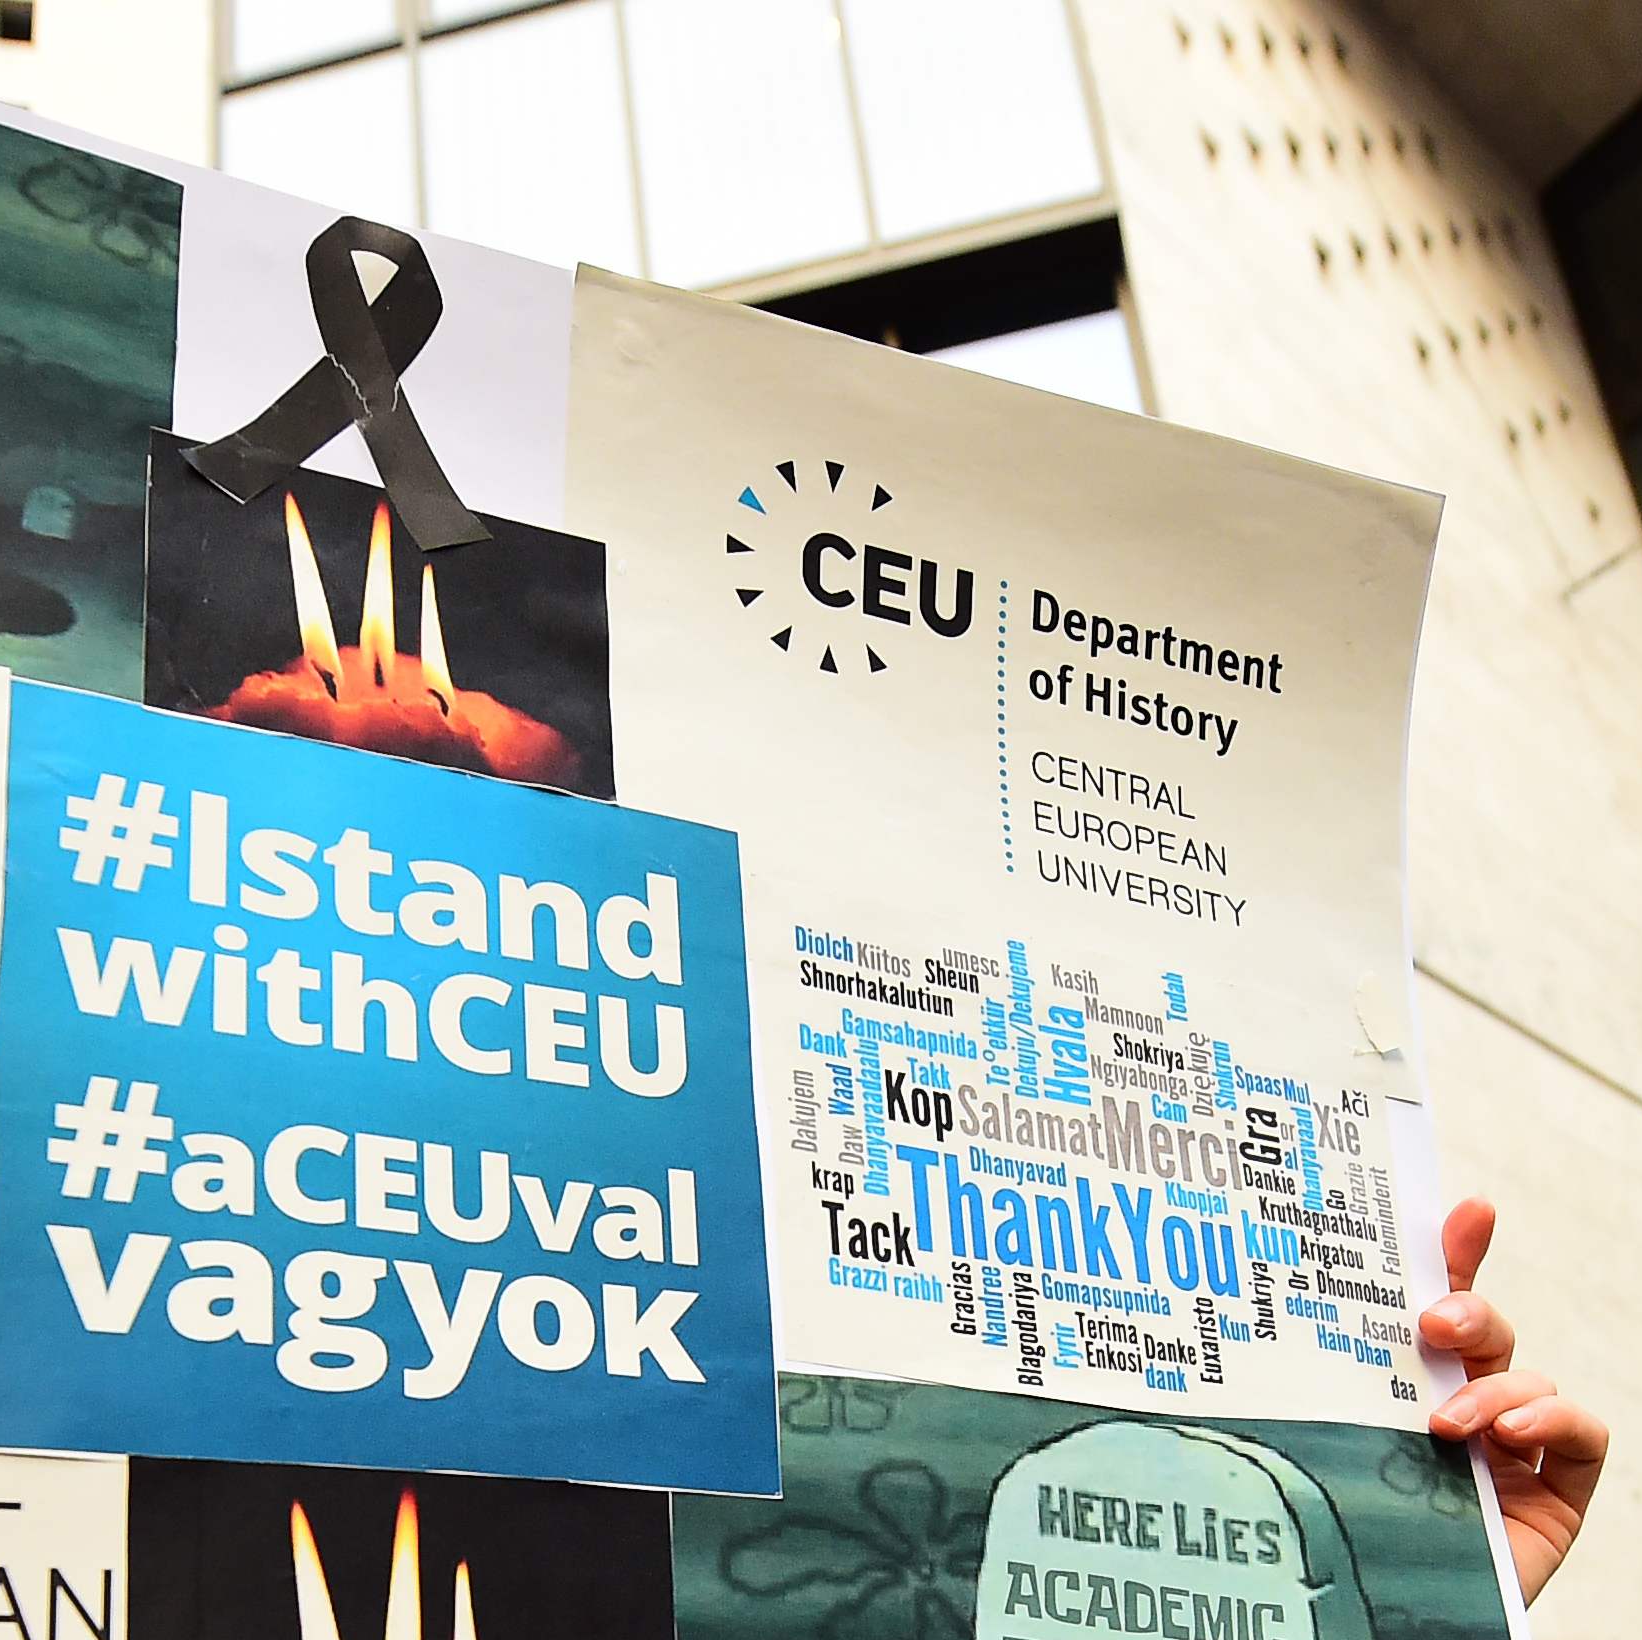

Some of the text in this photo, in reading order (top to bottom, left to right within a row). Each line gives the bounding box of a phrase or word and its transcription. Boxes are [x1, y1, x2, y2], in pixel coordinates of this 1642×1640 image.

[801, 531, 974, 639] CEU
[1032, 589, 1283, 694] Department
[1029, 664, 1238, 757] of History
[1032, 751, 1196, 820] CENTRAL
[1034, 801, 1227, 876] EUROPEAN
[58, 771, 684, 987] #Istand
[1037, 850, 1246, 928] UNIVERSITY
[795, 925, 854, 963] Diolch
[857, 941, 911, 978] Kiitos
[943, 947, 999, 978] umesc
[800, 960, 954, 1018] Shnorhakalutiun
[925, 958, 979, 994] Sheun
[1051, 963, 1099, 995] Kasih
[1161, 971, 1189, 1022] Todah
[55, 925, 689, 1098] withCEU
[842, 1007, 978, 1061] Gamsahapnida
[1084, 996, 1164, 1036] Mamnoon
[799, 1022, 847, 1059] Dank
[1038, 1005, 1092, 1107] Hvala
[1113, 1032, 1185, 1074] Shokriya
[826, 1062, 855, 1117] Waad
[907, 1056, 951, 1090] Takk
[1090, 1054, 1188, 1101] Ngiyabonga
[1212, 1040, 1237, 1111] Shokrun
[1234, 1065, 1282, 1097] Spaas
[1283, 1077, 1311, 1106] Mul
[788, 1069, 821, 1154] Dakujem
[885, 1068, 954, 1142] Kop
[958, 1083, 1105, 1161] Salamat
[1152, 1093, 1188, 1123] Cam
[838, 1124, 864, 1166] Daw
[1102, 1094, 1243, 1190] Merci
[1239, 1107, 1282, 1166] Gra
[1280, 1122, 1295, 1142] or
[1313, 1102, 1361, 1157] Xie
[46, 1075, 699, 1267] #aCEUval
[811, 1160, 855, 1200] krap
[969, 1145, 1067, 1187] Dhanyavad
[1242, 1163, 1296, 1196] Dankie
[1284, 1147, 1298, 1170] al
[1290, 1106, 1324, 1212] Dhanyavaad
[1164, 1181, 1229, 1218] Khopjai
[1325, 1189, 1346, 1211] Go
[1345, 1162, 1369, 1216] Grazie
[821, 1199, 916, 1267] Tack
[895, 1144, 1241, 1298] ThankYou
[1241, 1208, 1300, 1267] kun
[1258, 1195, 1377, 1242] Kruthagnathalu
[1368, 1166, 1402, 1277] Faleminderit
[828, 1257, 888, 1292] Grazzi
[1300, 1235, 1365, 1270] Arigatou
[946, 1260, 977, 1335] Gracias
[1041, 1272, 1172, 1317] Gomapsupnida
[1248, 1260, 1277, 1341] Shukriya
[1288, 1270, 1309, 1291] Or
[1316, 1269, 1406, 1310] Dhonnobaad
[44, 1223, 707, 1400] vagyok
[978, 1265, 1008, 1347] Nandree
[1008, 1271, 1046, 1387] Blagodariya
[1074, 1311, 1139, 1345] Terima
[1218, 1312, 1251, 1344] Kun
[1285, 1292, 1339, 1324] ederim
[1050, 1322, 1084, 1370] Fyrir
[1143, 1333, 1197, 1365] Danke
[1193, 1296, 1224, 1385] Euxaristo
[1316, 1323, 1352, 1354] Hain
[1353, 1337, 1393, 1368] Dhan
[1362, 1313, 1413, 1347] Asante
[1085, 1340, 1143, 1374] Enkosi
[1145, 1363, 1188, 1393] dank
[1391, 1374, 1418, 1402] daa
[1037, 1483, 1164, 1551] HERE
